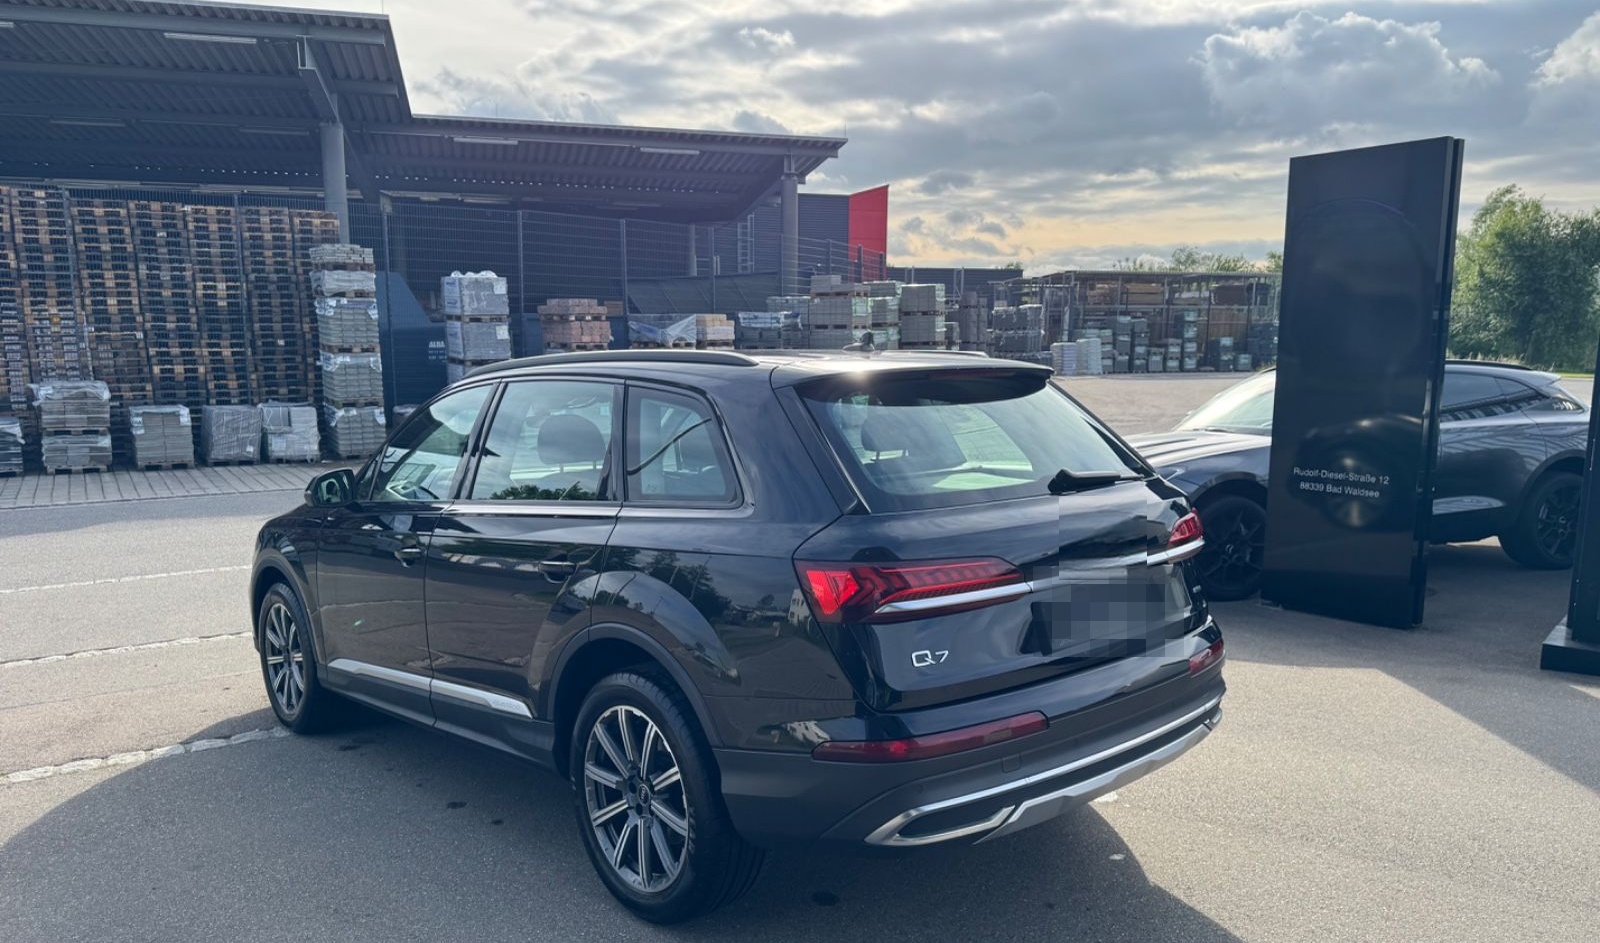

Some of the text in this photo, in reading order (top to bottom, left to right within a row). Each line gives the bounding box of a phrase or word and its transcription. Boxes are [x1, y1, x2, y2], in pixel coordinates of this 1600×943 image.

[1293, 467, 1390, 485] Rudolf-Diesel-Straße 12
[1300, 481, 1380, 498] 88339 Bad Waldsee
[912, 650, 949, 667] Q7
